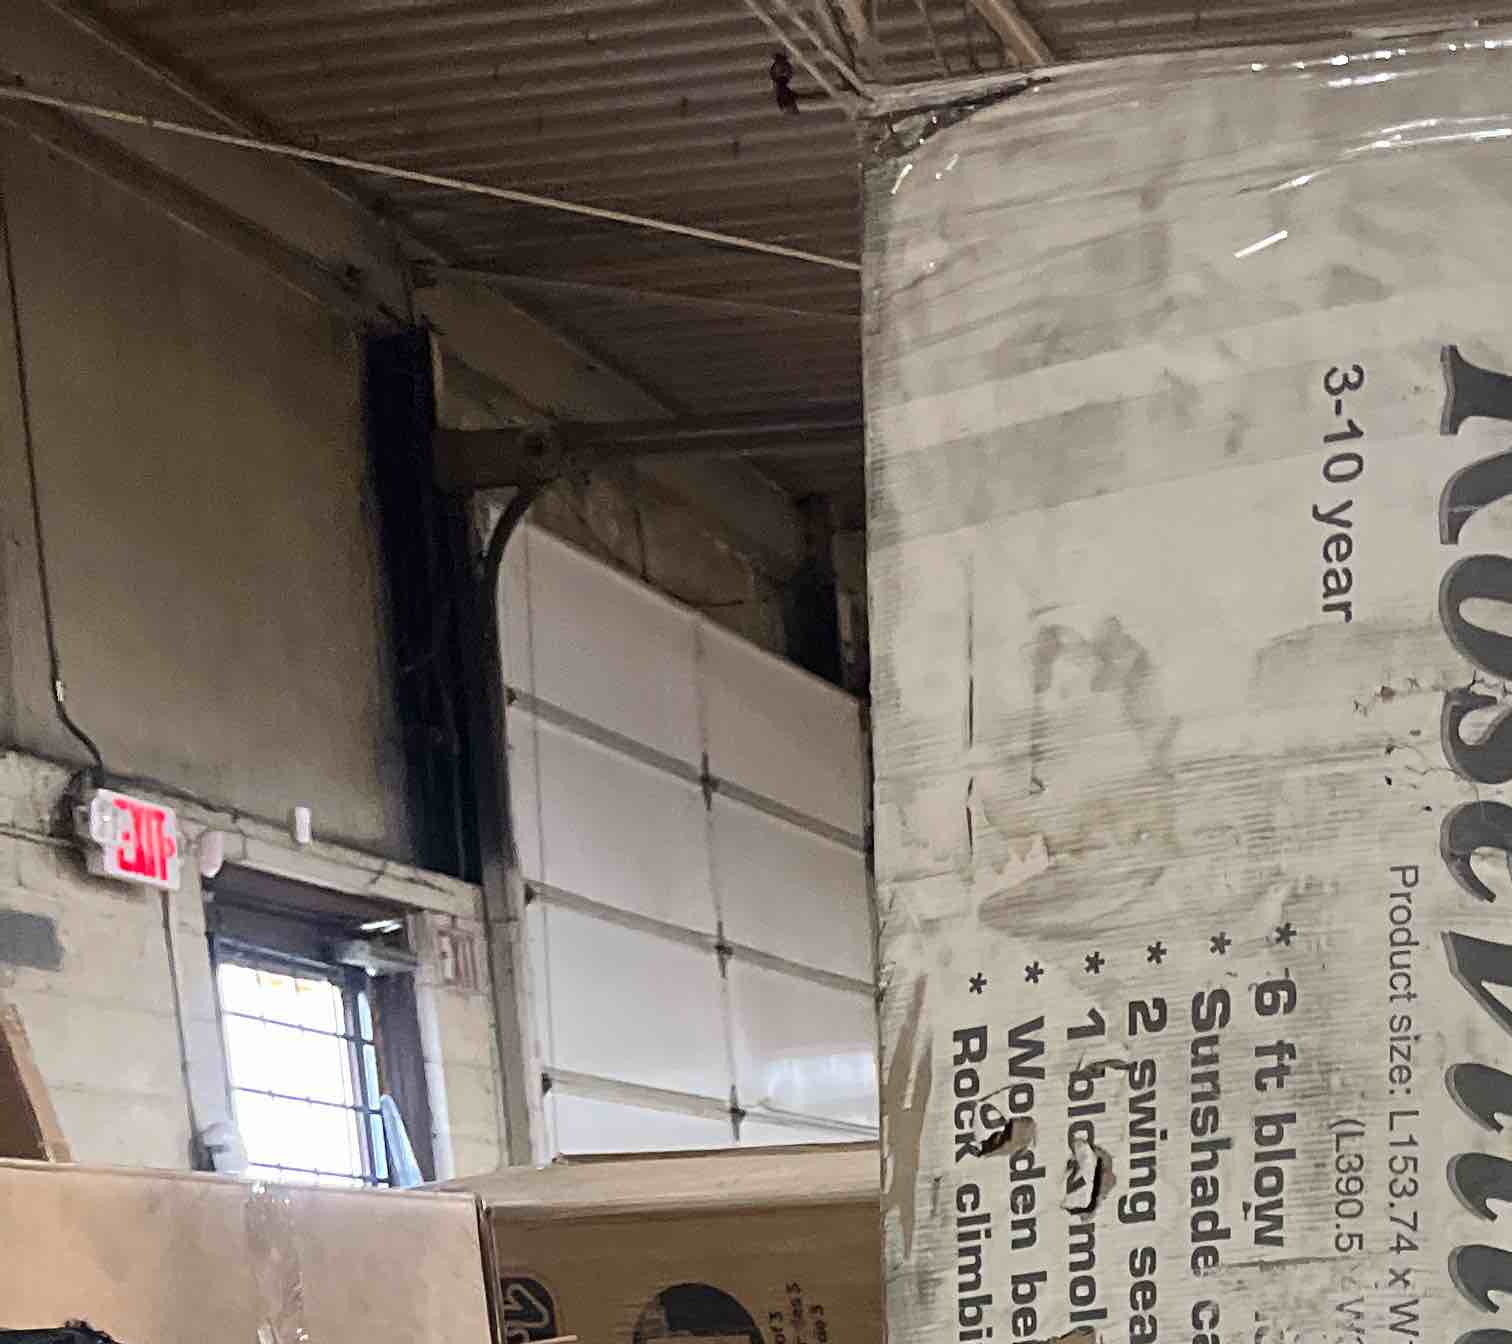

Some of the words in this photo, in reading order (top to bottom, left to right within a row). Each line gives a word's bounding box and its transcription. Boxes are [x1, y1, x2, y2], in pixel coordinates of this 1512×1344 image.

[1322, 363, 1364, 485] 3-10
[1311, 499, 1359, 624] year
[1252, 977, 1295, 1017] 6
[1386, 863, 1422, 1002] Product
[1067, 1008, 1105, 1039] 1
[1127, 998, 1166, 1037] 2
[1253, 1039, 1296, 1092] ft
[1387, 1011, 1422, 1098] size:
[952, 1025, 990, 1162] Rock
[1118, 1059, 1166, 1224] swing
[1189, 989, 1232, 1278] Sunshade
[1253, 1112, 1297, 1248] blow
[1330, 1117, 1366, 1254] (L390.5
[1387, 1108, 1420, 1256] L153.74
